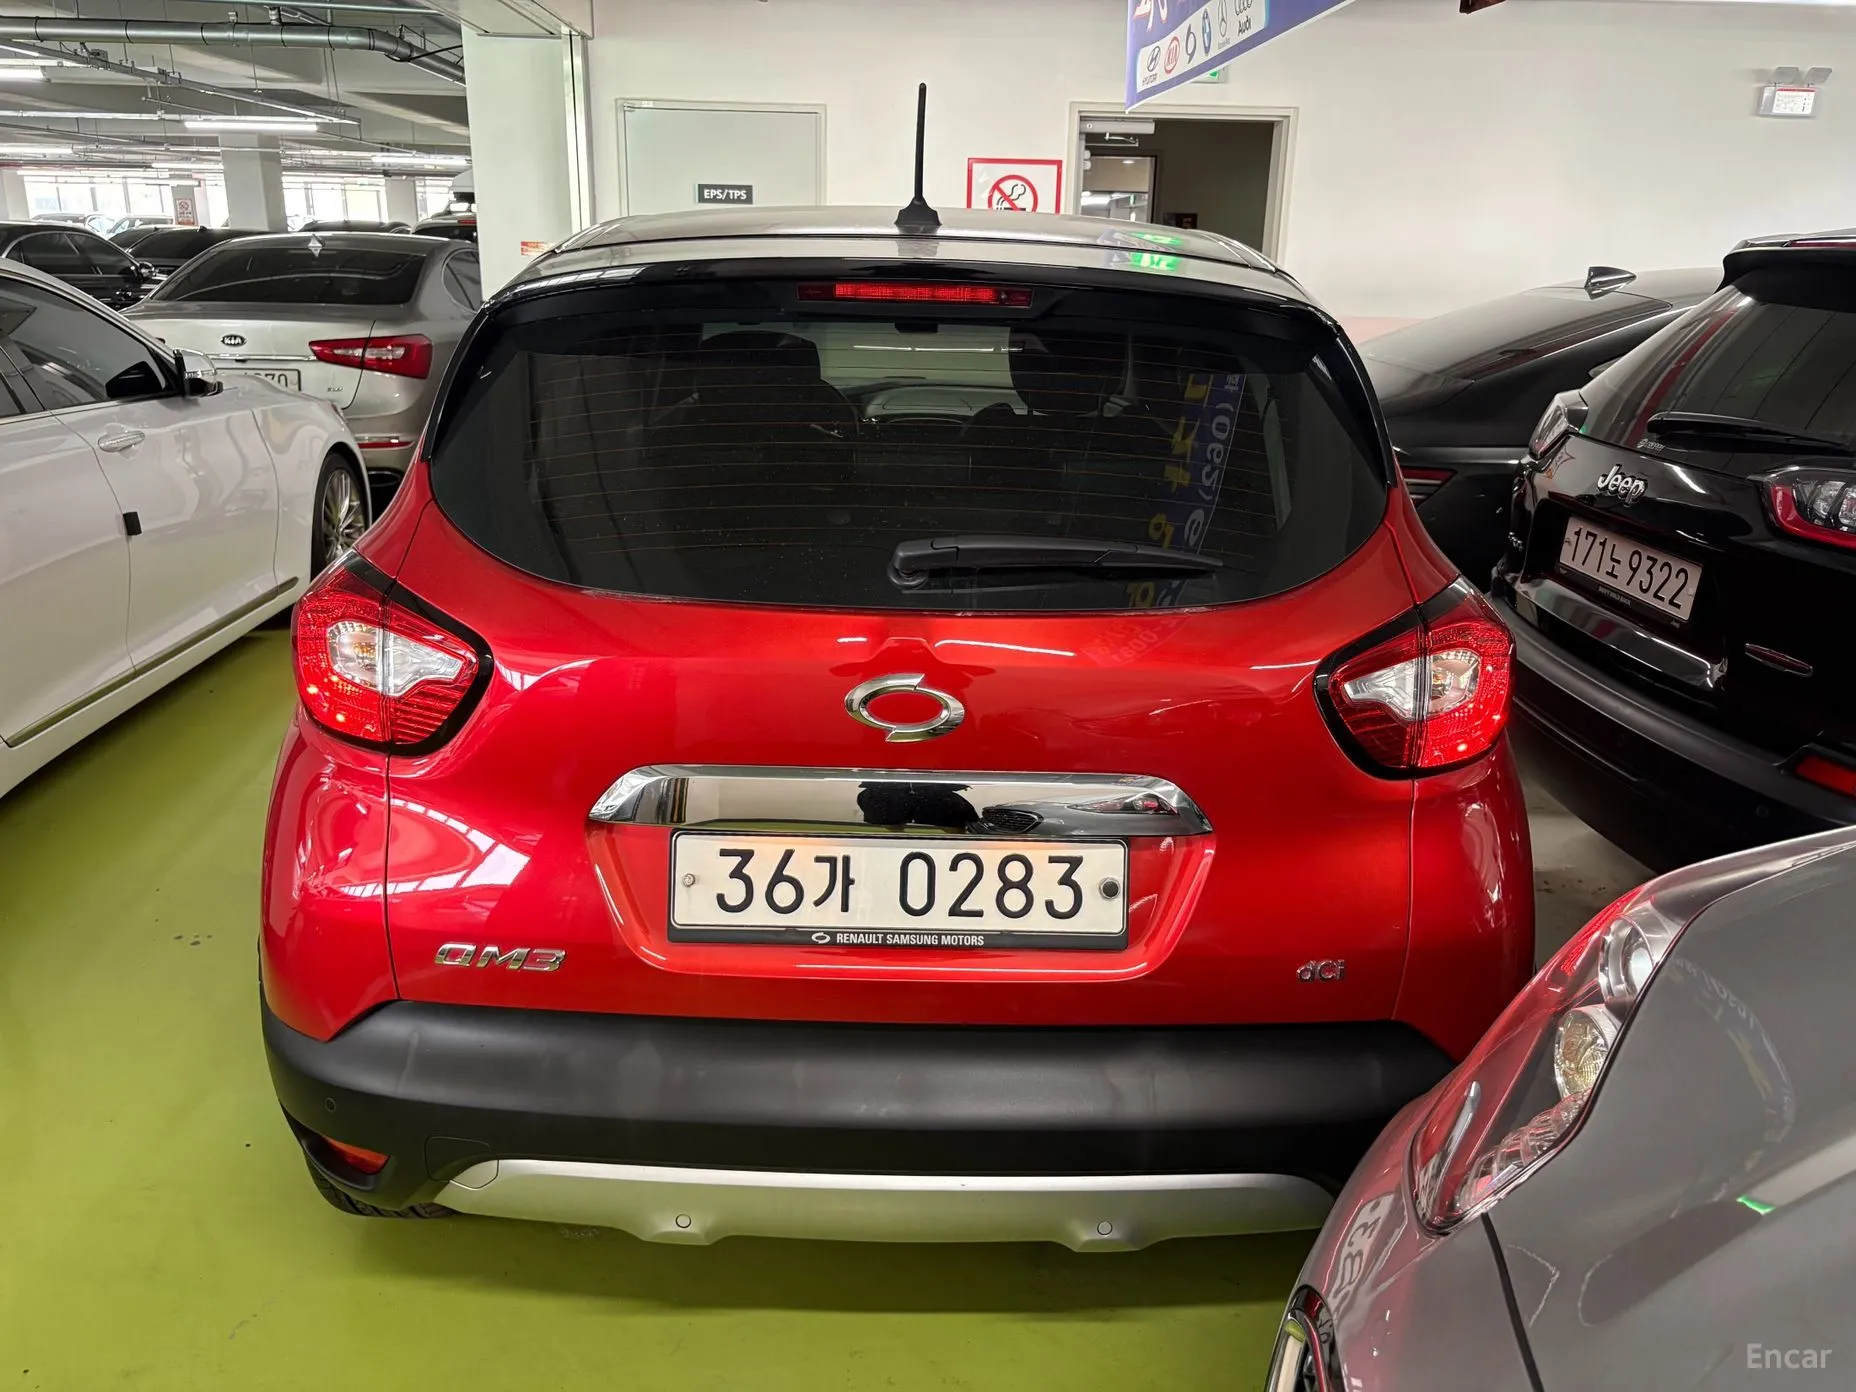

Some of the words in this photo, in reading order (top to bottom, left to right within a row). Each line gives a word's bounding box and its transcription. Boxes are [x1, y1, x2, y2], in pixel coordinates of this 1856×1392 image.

[703, 188, 747, 200] EPS/TPS
[222, 335, 244, 346] KIA
[1597, 464, 1647, 505] Jeep
[715, 847, 856, 915] 36가
[899, 851, 1085, 920] 0283
[836, 932, 884, 944] RENAULT
[886, 933, 939, 945] SAMSUNG
[941, 935, 985, 946] MOTORS
[434, 941, 567, 972] QM3
[1296, 959, 1346, 982] dCi
